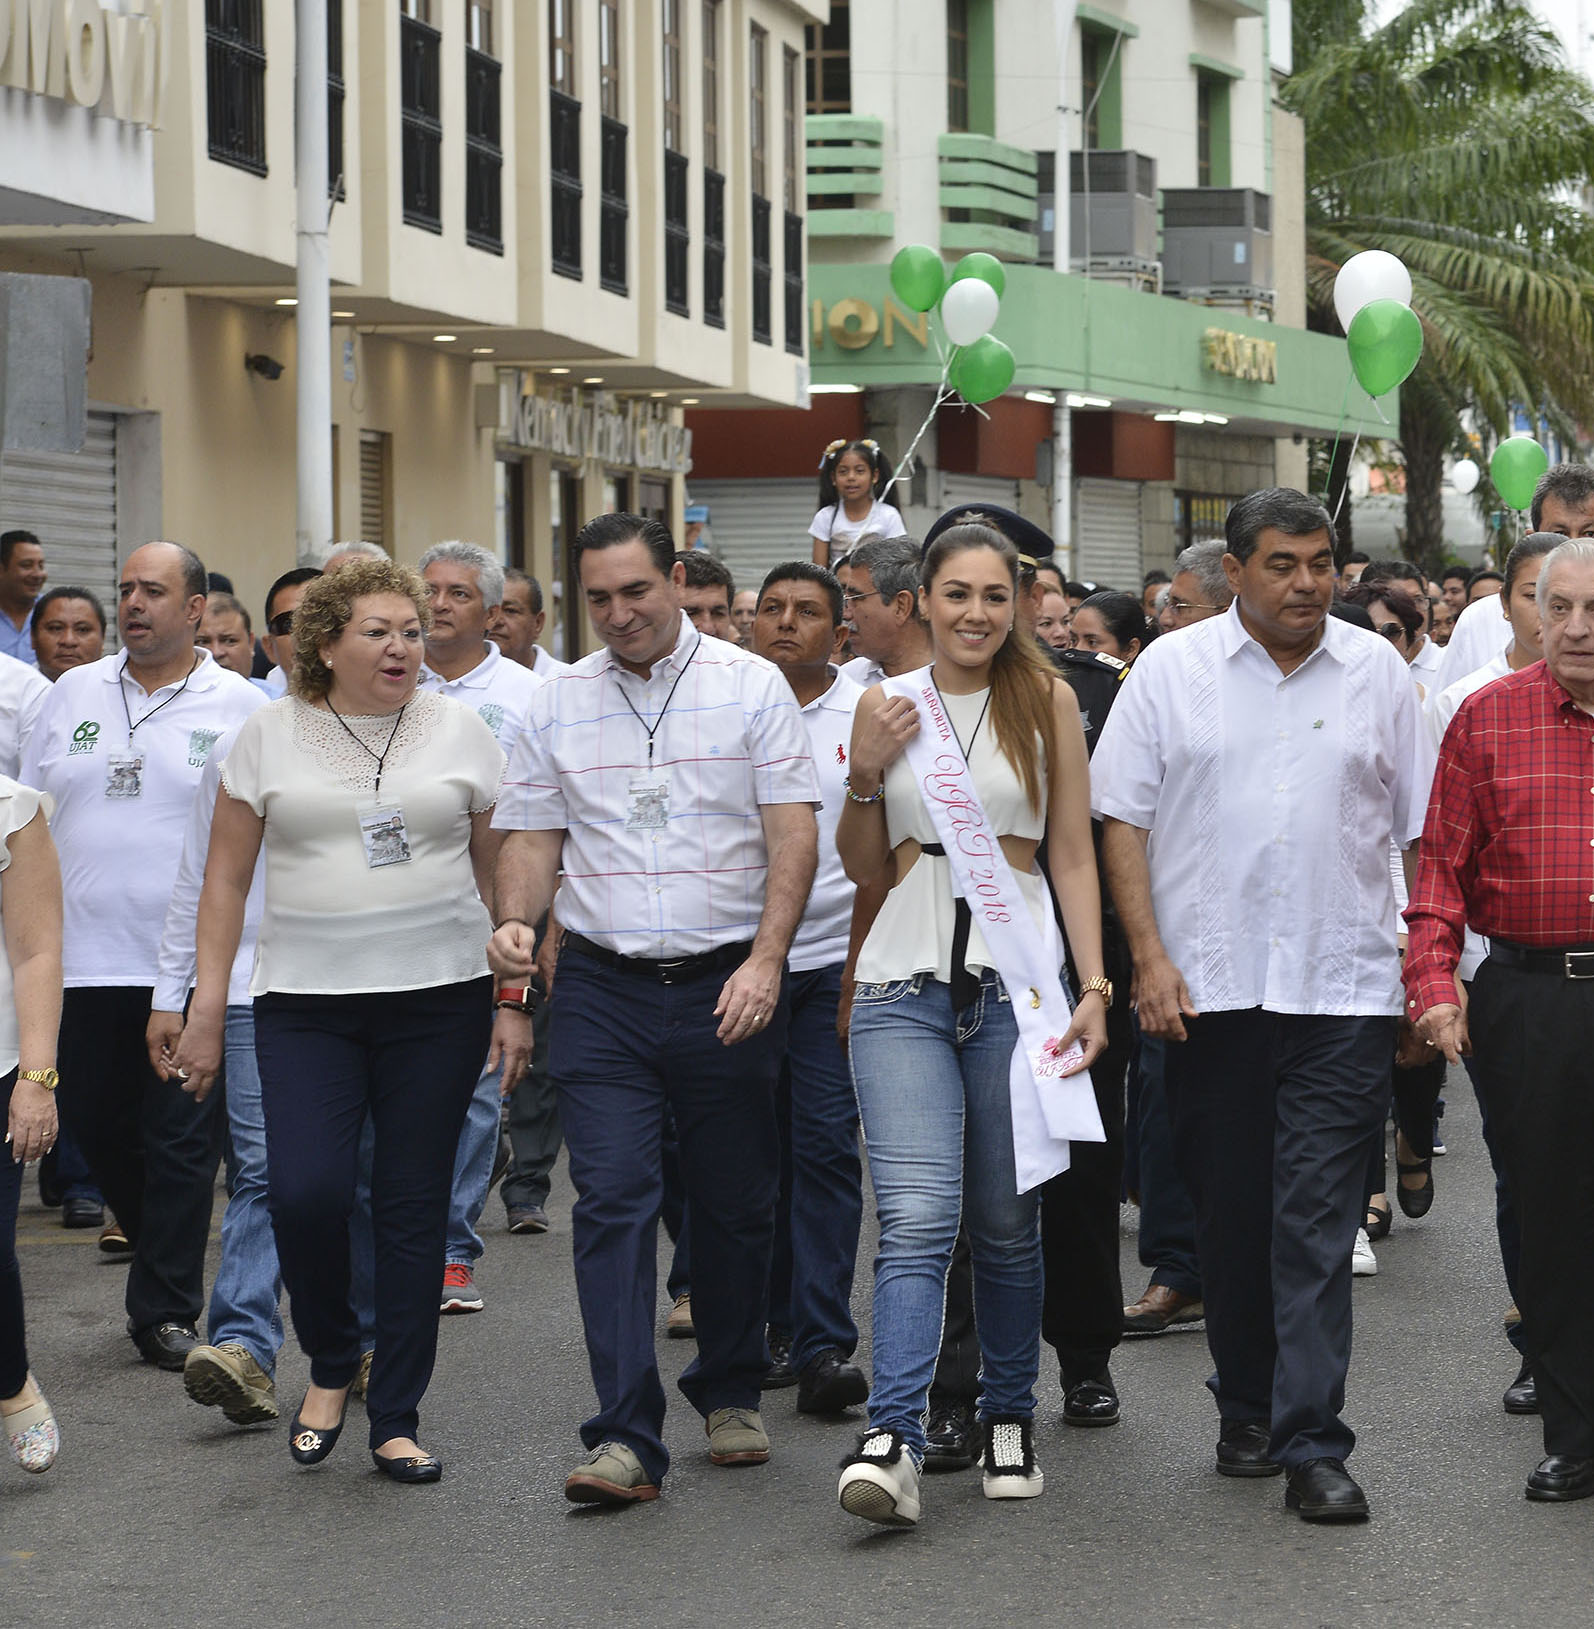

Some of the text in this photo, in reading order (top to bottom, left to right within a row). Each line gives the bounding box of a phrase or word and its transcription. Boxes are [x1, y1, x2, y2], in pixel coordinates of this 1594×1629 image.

[69, 741, 98, 753] UJAT
[921, 687, 952, 742] SEÑORITA
[968, 868, 1012, 924] 2018
